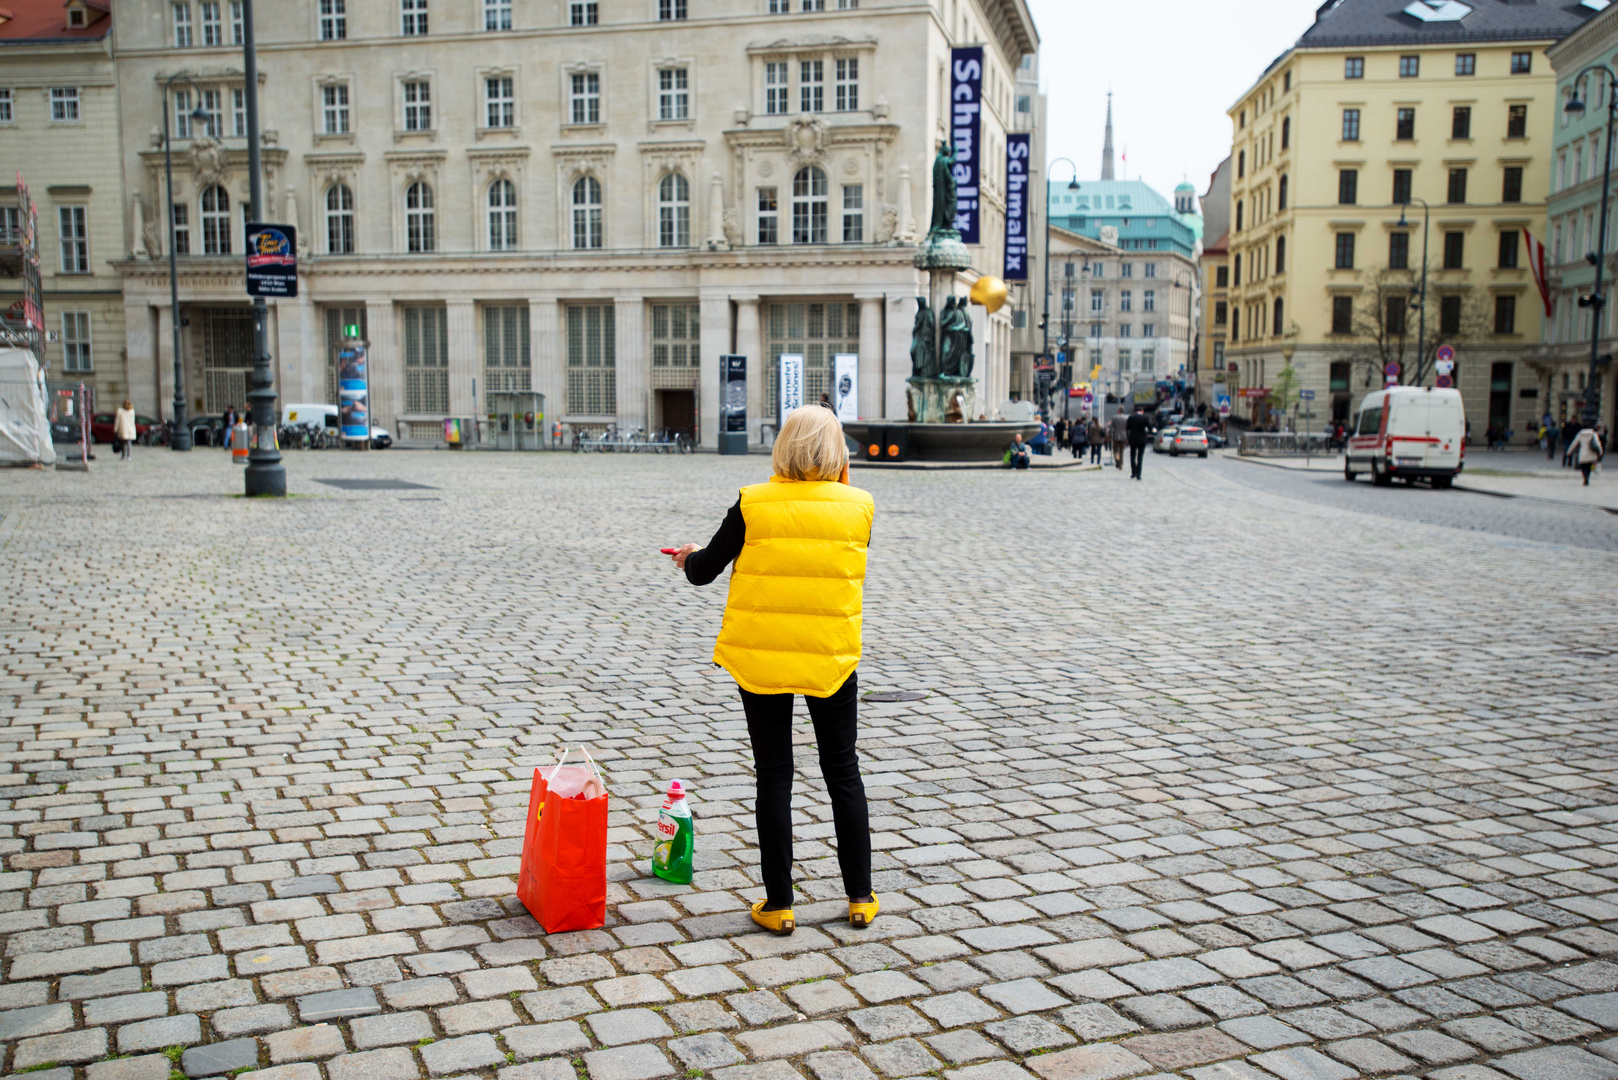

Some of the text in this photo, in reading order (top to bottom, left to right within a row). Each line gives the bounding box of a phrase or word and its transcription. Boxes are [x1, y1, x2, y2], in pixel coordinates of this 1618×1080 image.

[953, 58, 981, 232] Schmalix
[1007, 141, 1028, 271] Schmalix
[784, 361, 792, 410] Vermehrt
[792, 360, 800, 409] Schönes!
[657, 819, 675, 836] ersil
